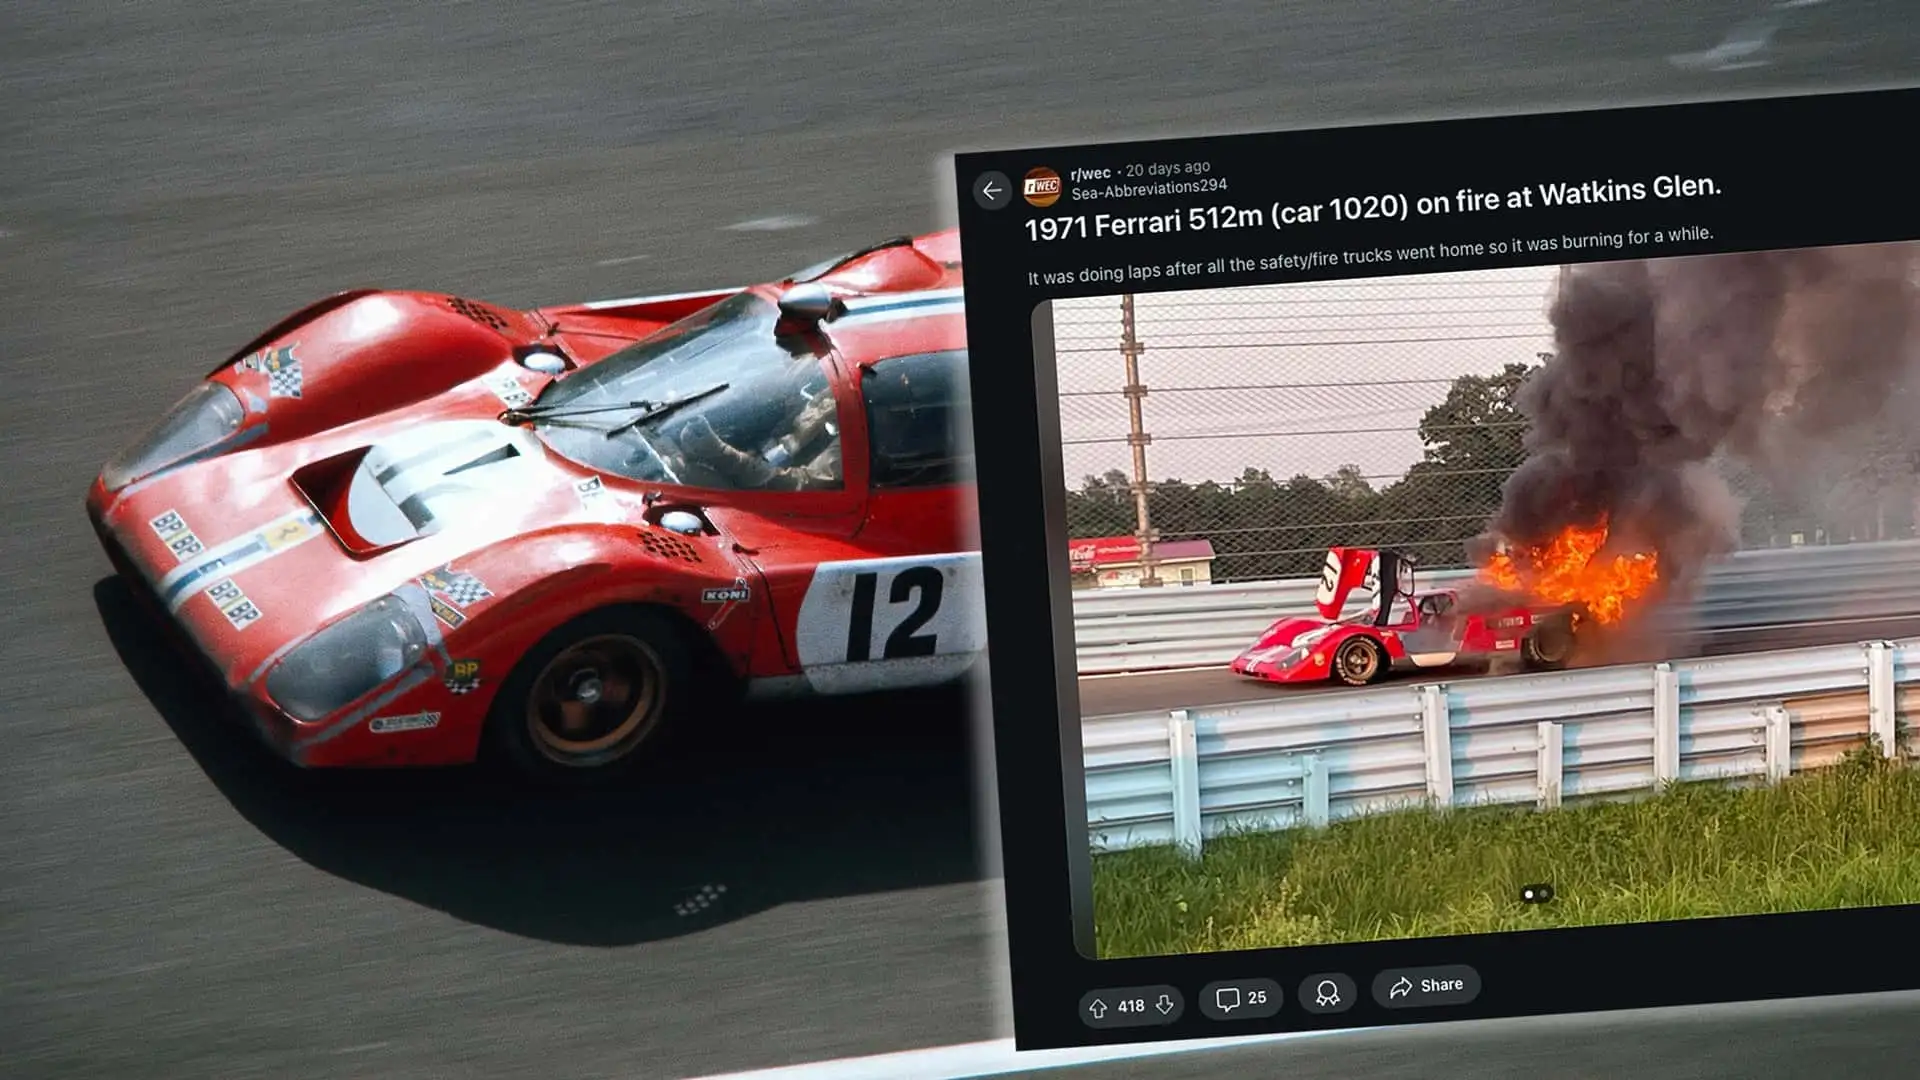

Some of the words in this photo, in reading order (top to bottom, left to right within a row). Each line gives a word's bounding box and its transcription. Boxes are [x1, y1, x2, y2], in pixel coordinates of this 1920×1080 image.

[1071, 168, 1112, 184] r/wec
[1126, 164, 1144, 177] 20
[1149, 163, 1181, 177] days
[1185, 162, 1211, 175] ago
[1036, 180, 1057, 192] WEC
[1072, 178, 1228, 201] Sea-Abbreviations294
[1025, 216, 1087, 242] 1971
[1095, 209, 1181, 237] Ferrari
[1189, 206, 1263, 231] 512m
[1271, 203, 1324, 230] (car
[1329, 193, 1408, 221] 1020)
[1416, 197, 1450, 215] on
[1455, 189, 1500, 212] fire
[1506, 187, 1533, 209] at
[1538, 179, 1647, 206] Watkins
[1653, 175, 1722, 199] Glen.
[1028, 272, 1040, 286] It
[1043, 272, 1075, 285] was
[1079, 267, 1124, 284] doing
[1128, 265, 1161, 281] laps
[1165, 262, 1203, 277] after
[1207, 259, 1225, 274] all
[1229, 258, 1256, 272] the
[1259, 252, 1339, 271] safety/fire
[1343, 248, 1393, 265] trucks
[1396, 246, 1436, 261] went
[1439, 244, 1484, 257] home
[1488, 242, 1508, 255] so
[1512, 239, 1523, 253] it
[1526, 239, 1558, 252] was
[1562, 233, 1623, 249] burning
[1627, 230, 1650, 245] for
[1654, 232, 1664, 243] a
[1668, 227, 1714, 242] while.
[154, 512, 182, 534] BP
[172, 535, 202, 557] BP
[209, 581, 240, 605] BP
[227, 602, 259, 624] BP
[706, 590, 746, 600] KONI
[846, 566, 944, 663] 12
[455, 662, 478, 677] BP
[1420, 977, 1464, 993] Share
[1117, 998, 1145, 1013] 418
[1247, 990, 1267, 1005] 25
